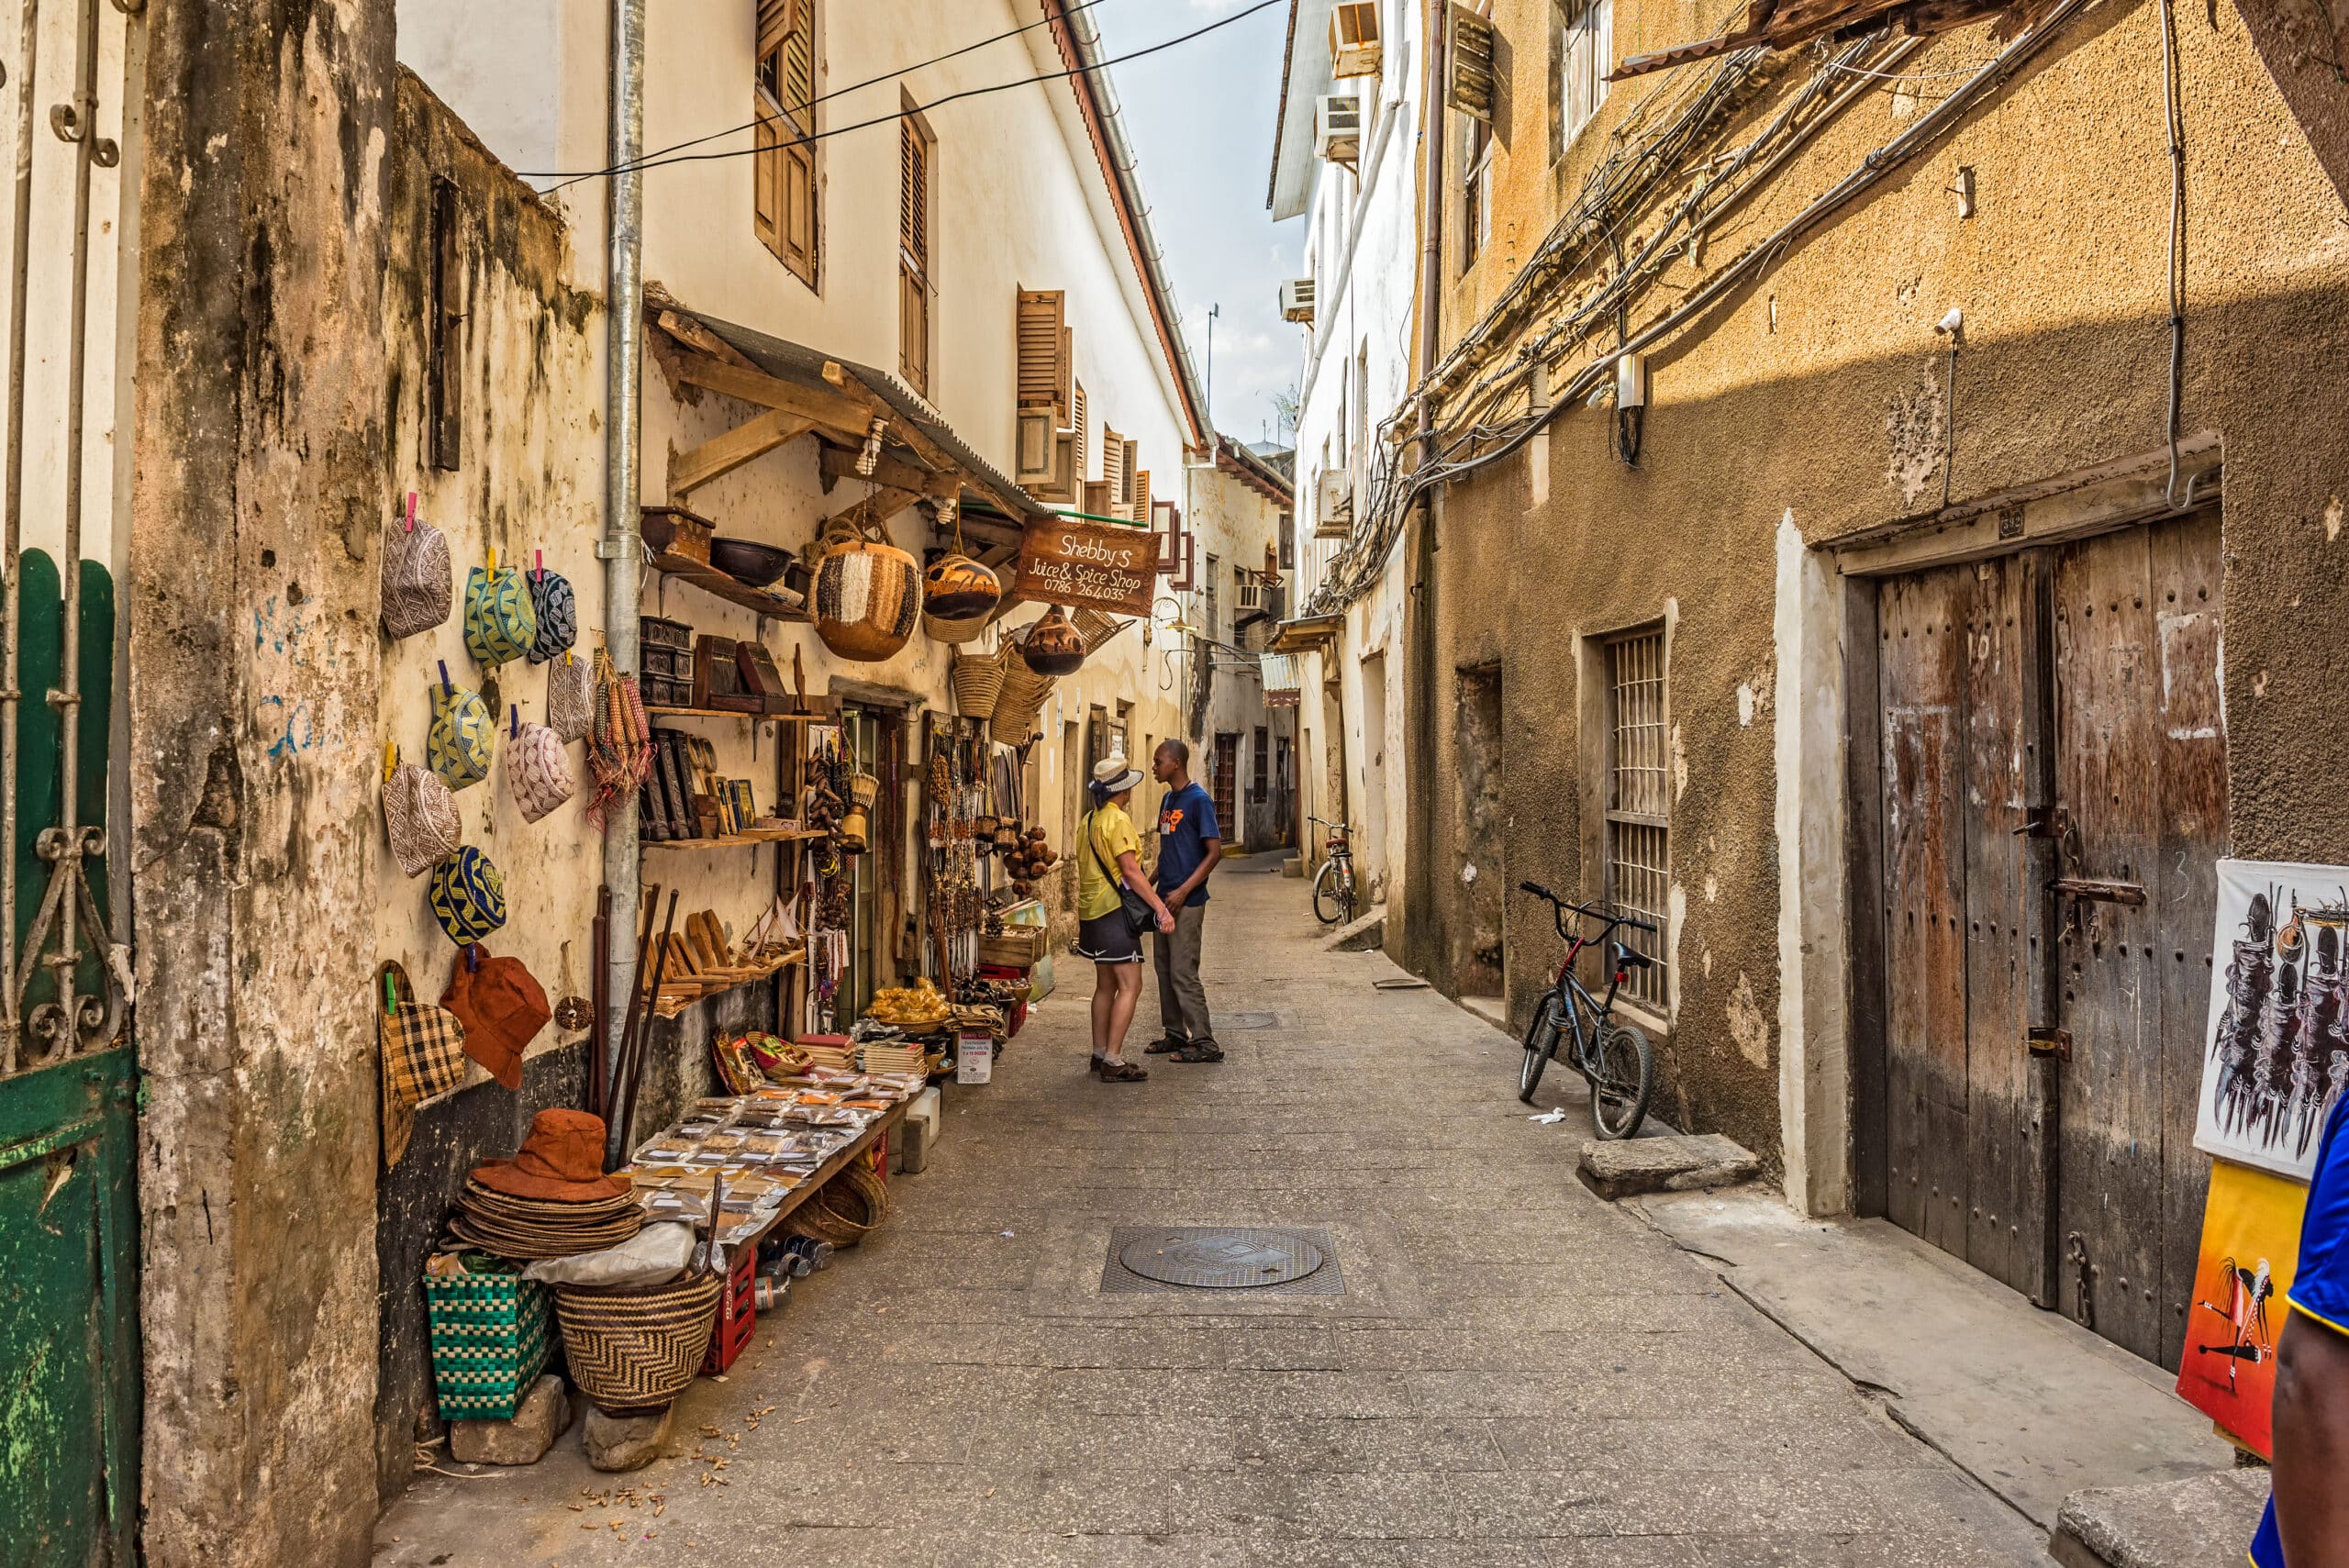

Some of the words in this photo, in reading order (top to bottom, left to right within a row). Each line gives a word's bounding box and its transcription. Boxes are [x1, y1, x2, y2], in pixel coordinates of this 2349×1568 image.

[1029, 558, 1059, 577] Juice
[1060, 562, 1072, 580] &
[1075, 564, 1108, 584] Spice
[1109, 569, 1141, 594] Shop
[1044, 579, 1073, 593] 0786
[1077, 584, 1127, 601] 264035
